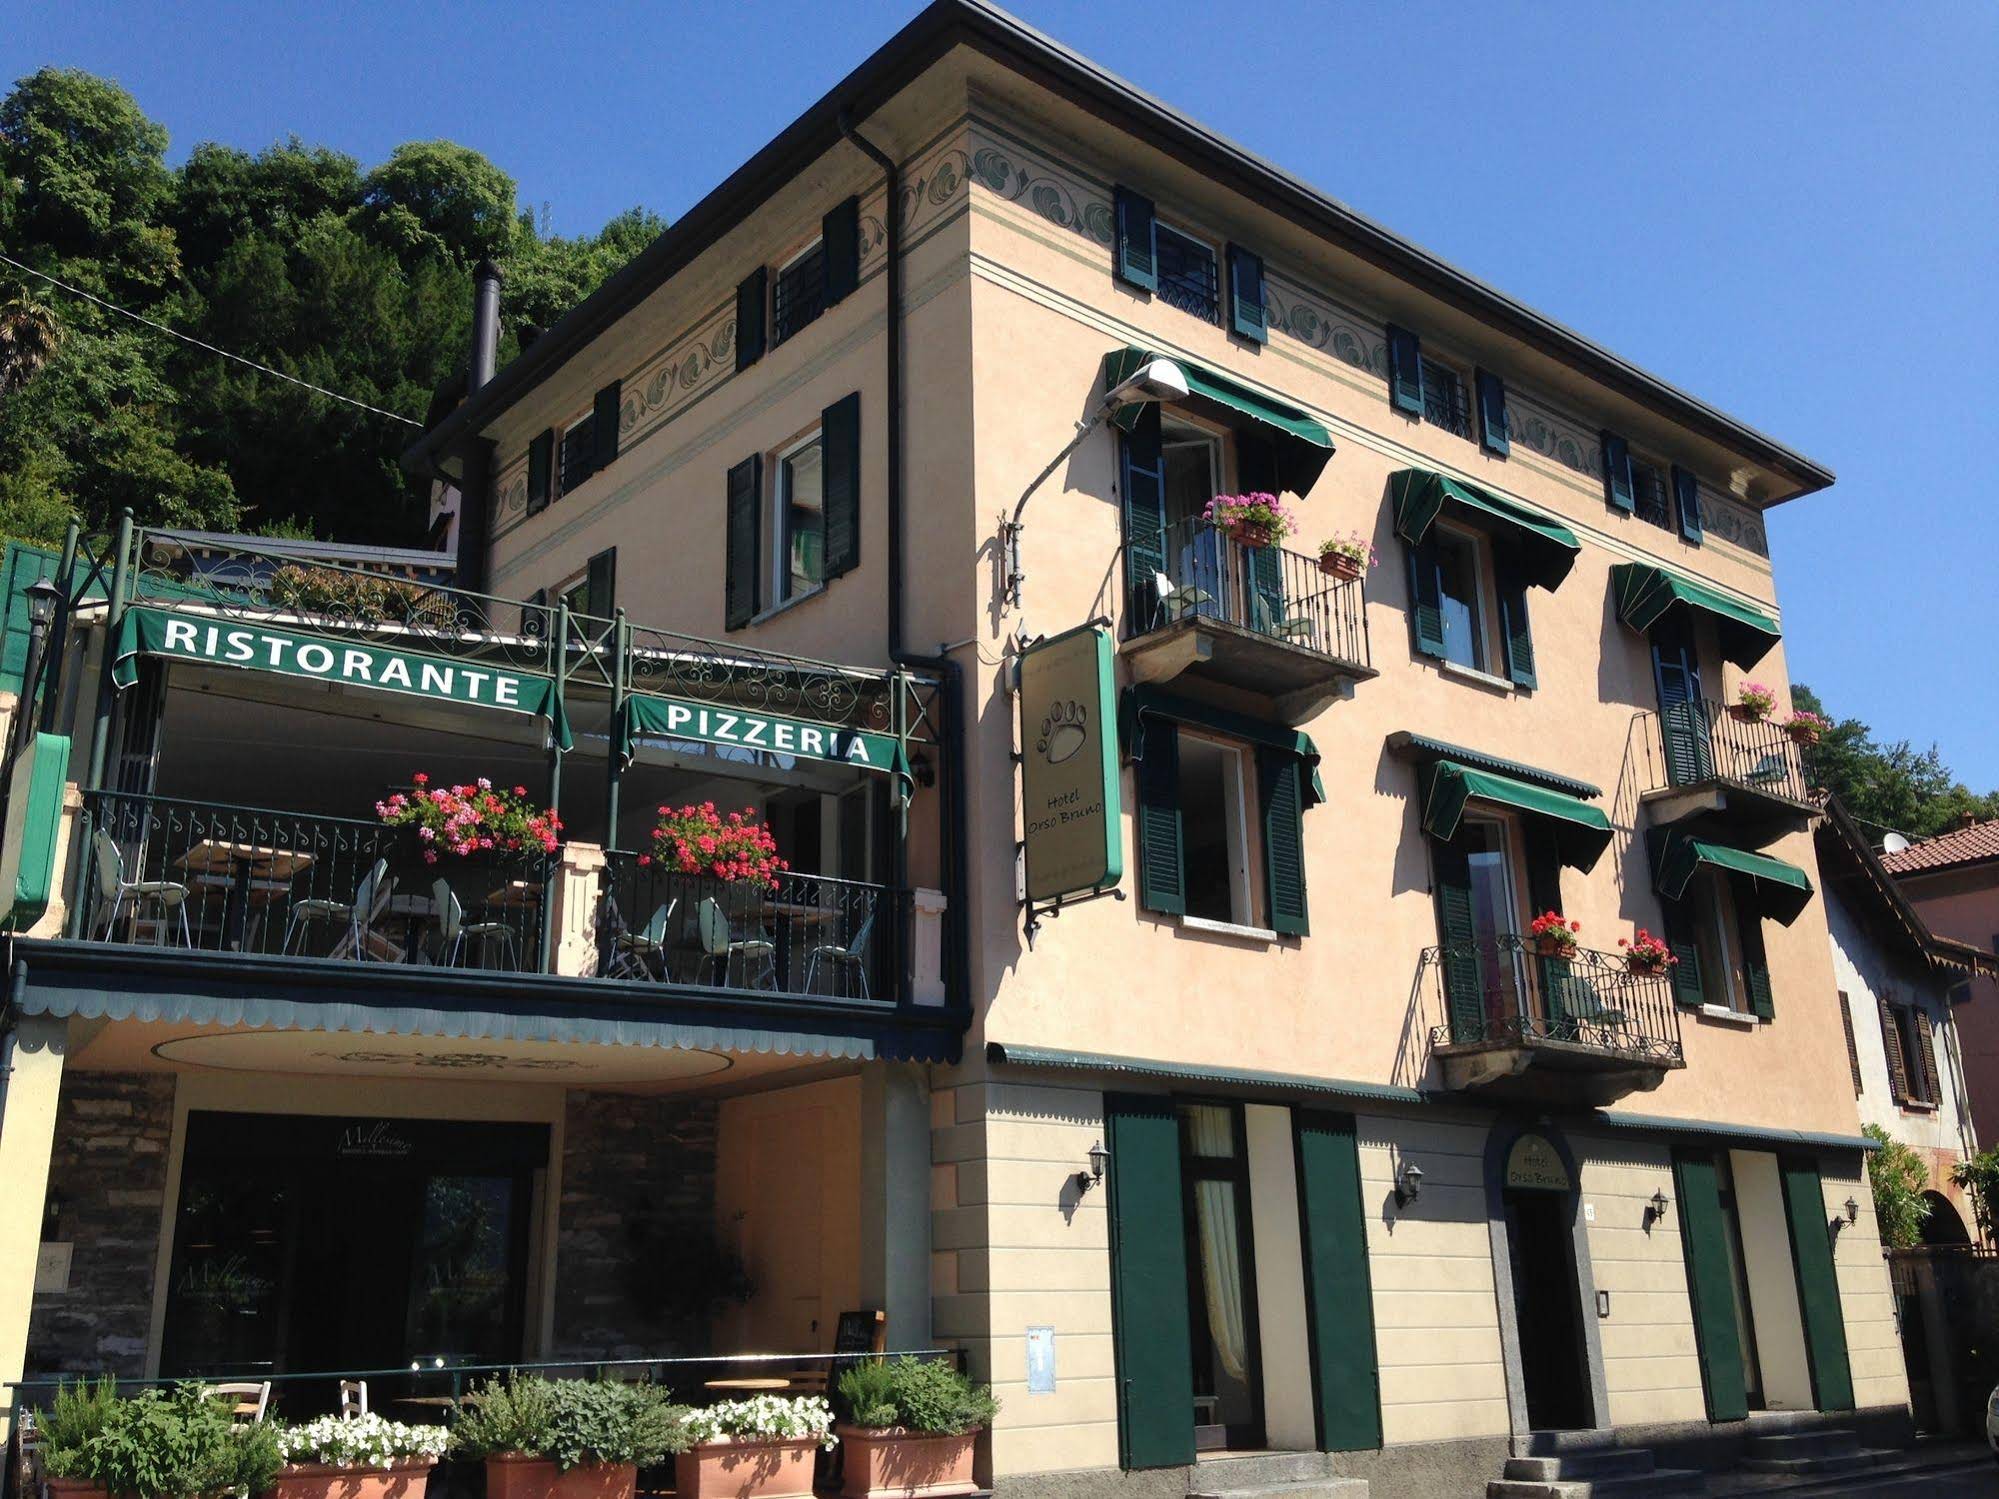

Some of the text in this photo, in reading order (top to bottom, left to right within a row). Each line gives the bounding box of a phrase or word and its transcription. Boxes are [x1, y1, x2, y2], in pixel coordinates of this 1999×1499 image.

[163, 619, 519, 706] RISTORANTE
[667, 704, 870, 762] PIZZERIA
[1028, 803, 1101, 834] Orso Bruno
[1048, 788, 1080, 808] Hotel
